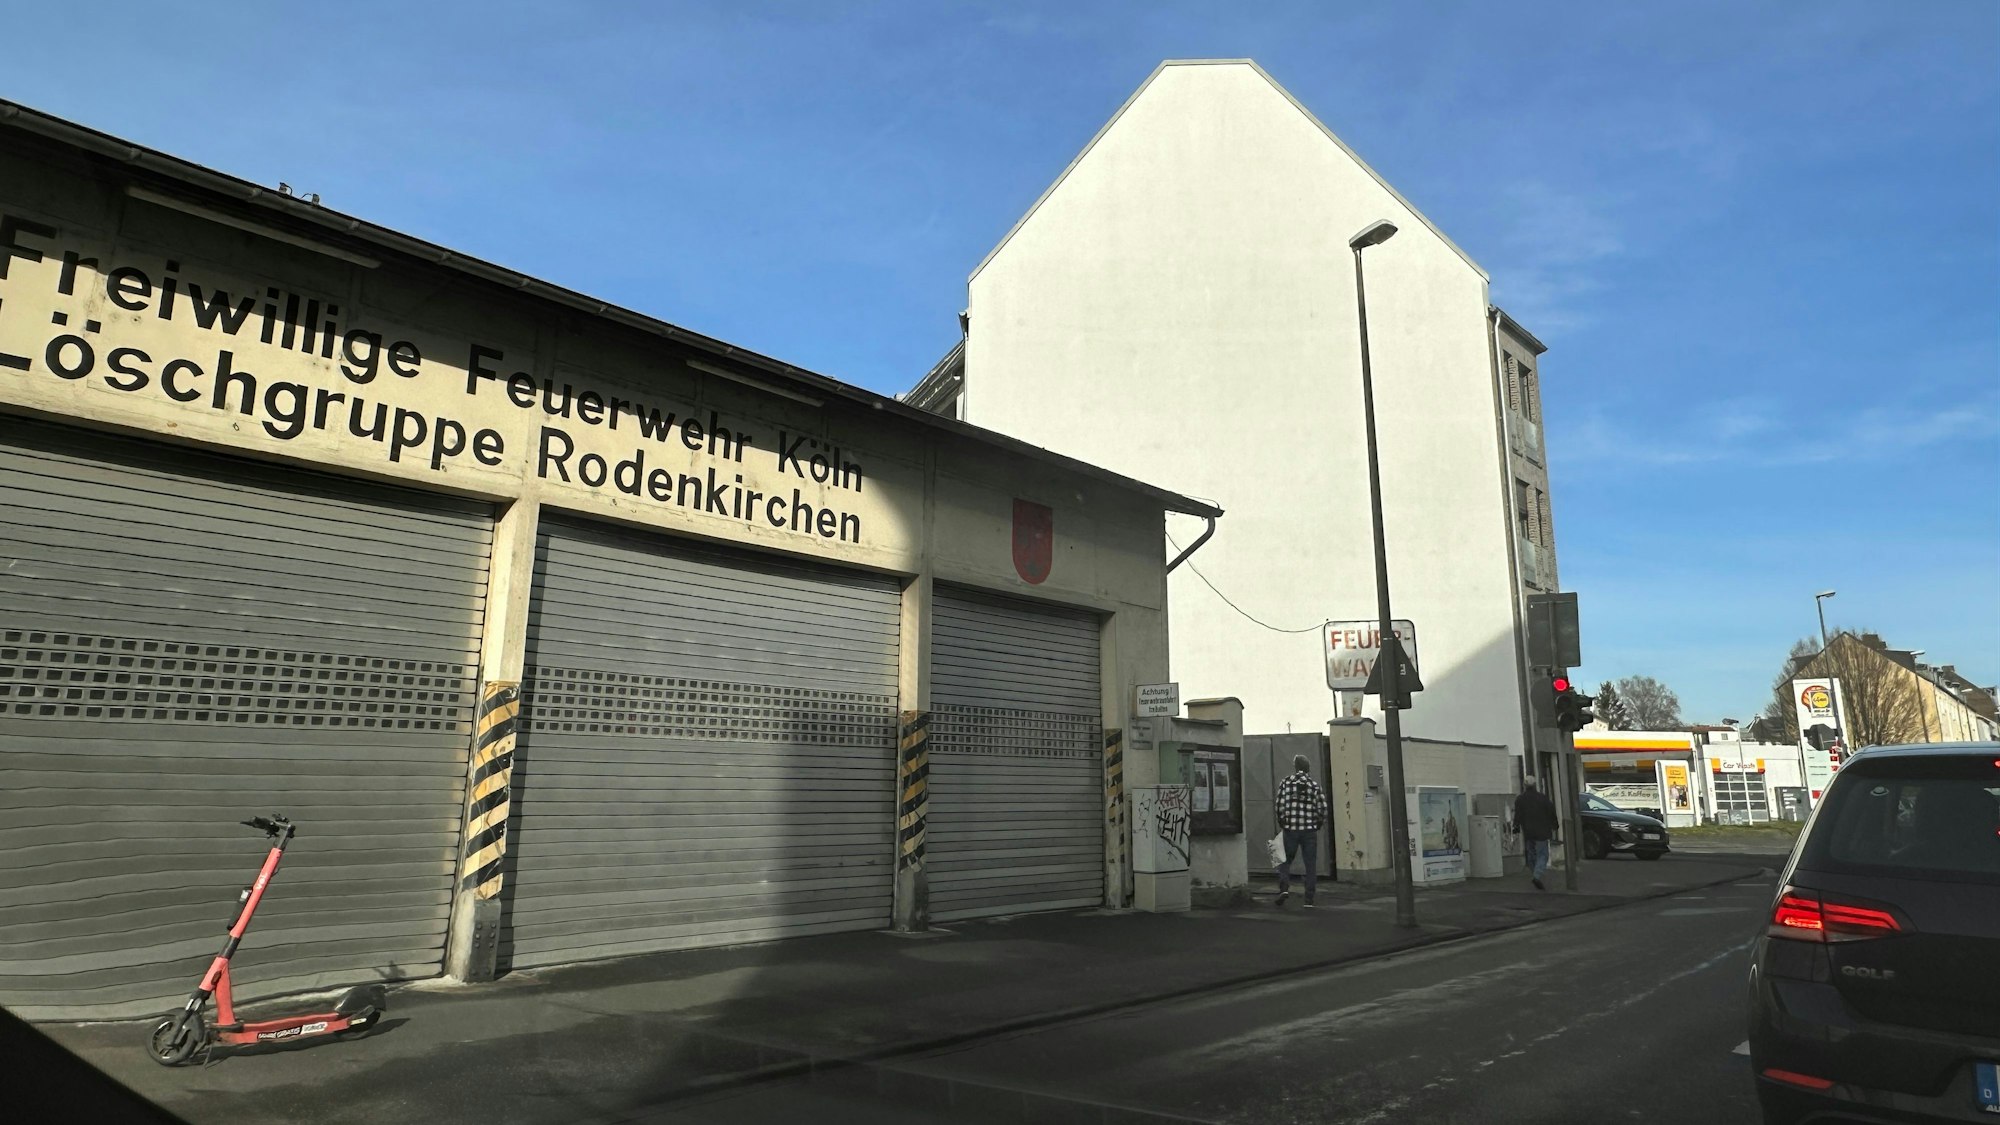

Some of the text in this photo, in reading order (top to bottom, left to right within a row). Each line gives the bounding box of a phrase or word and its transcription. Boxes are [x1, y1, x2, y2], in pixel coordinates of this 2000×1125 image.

[0, 214, 864, 493] Freiwillige Feuerwehr Köln
[537, 425, 861, 544] Rodenkirchen
[1841, 965, 1896, 980] GOLF
[1984, 1088, 1992, 1099] D
